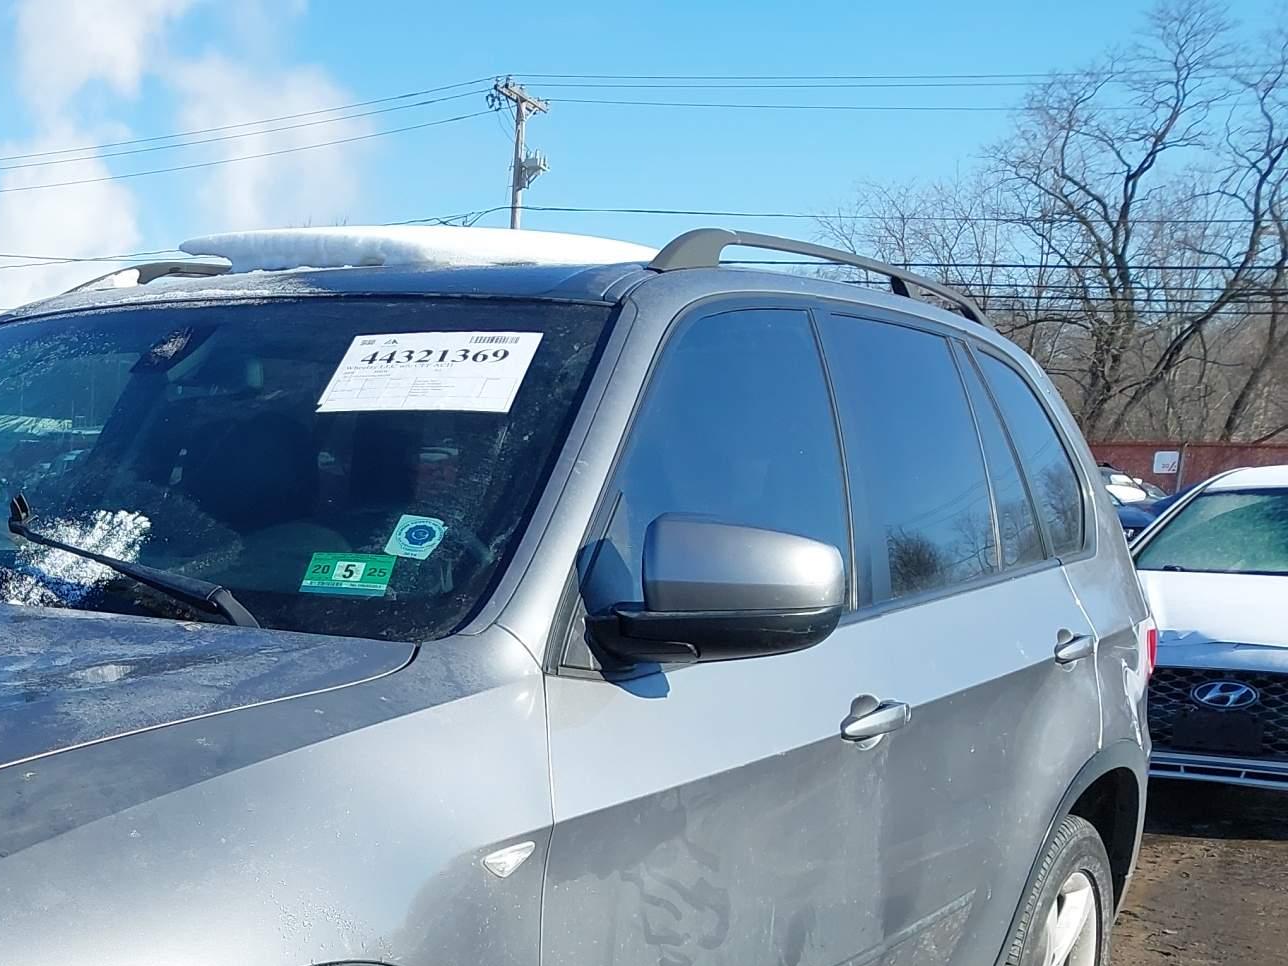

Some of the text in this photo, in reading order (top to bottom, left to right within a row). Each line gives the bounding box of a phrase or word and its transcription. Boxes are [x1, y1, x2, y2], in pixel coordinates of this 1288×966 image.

[360, 348, 510, 364] 44321369
[312, 564, 387, 579] 20 5 25
